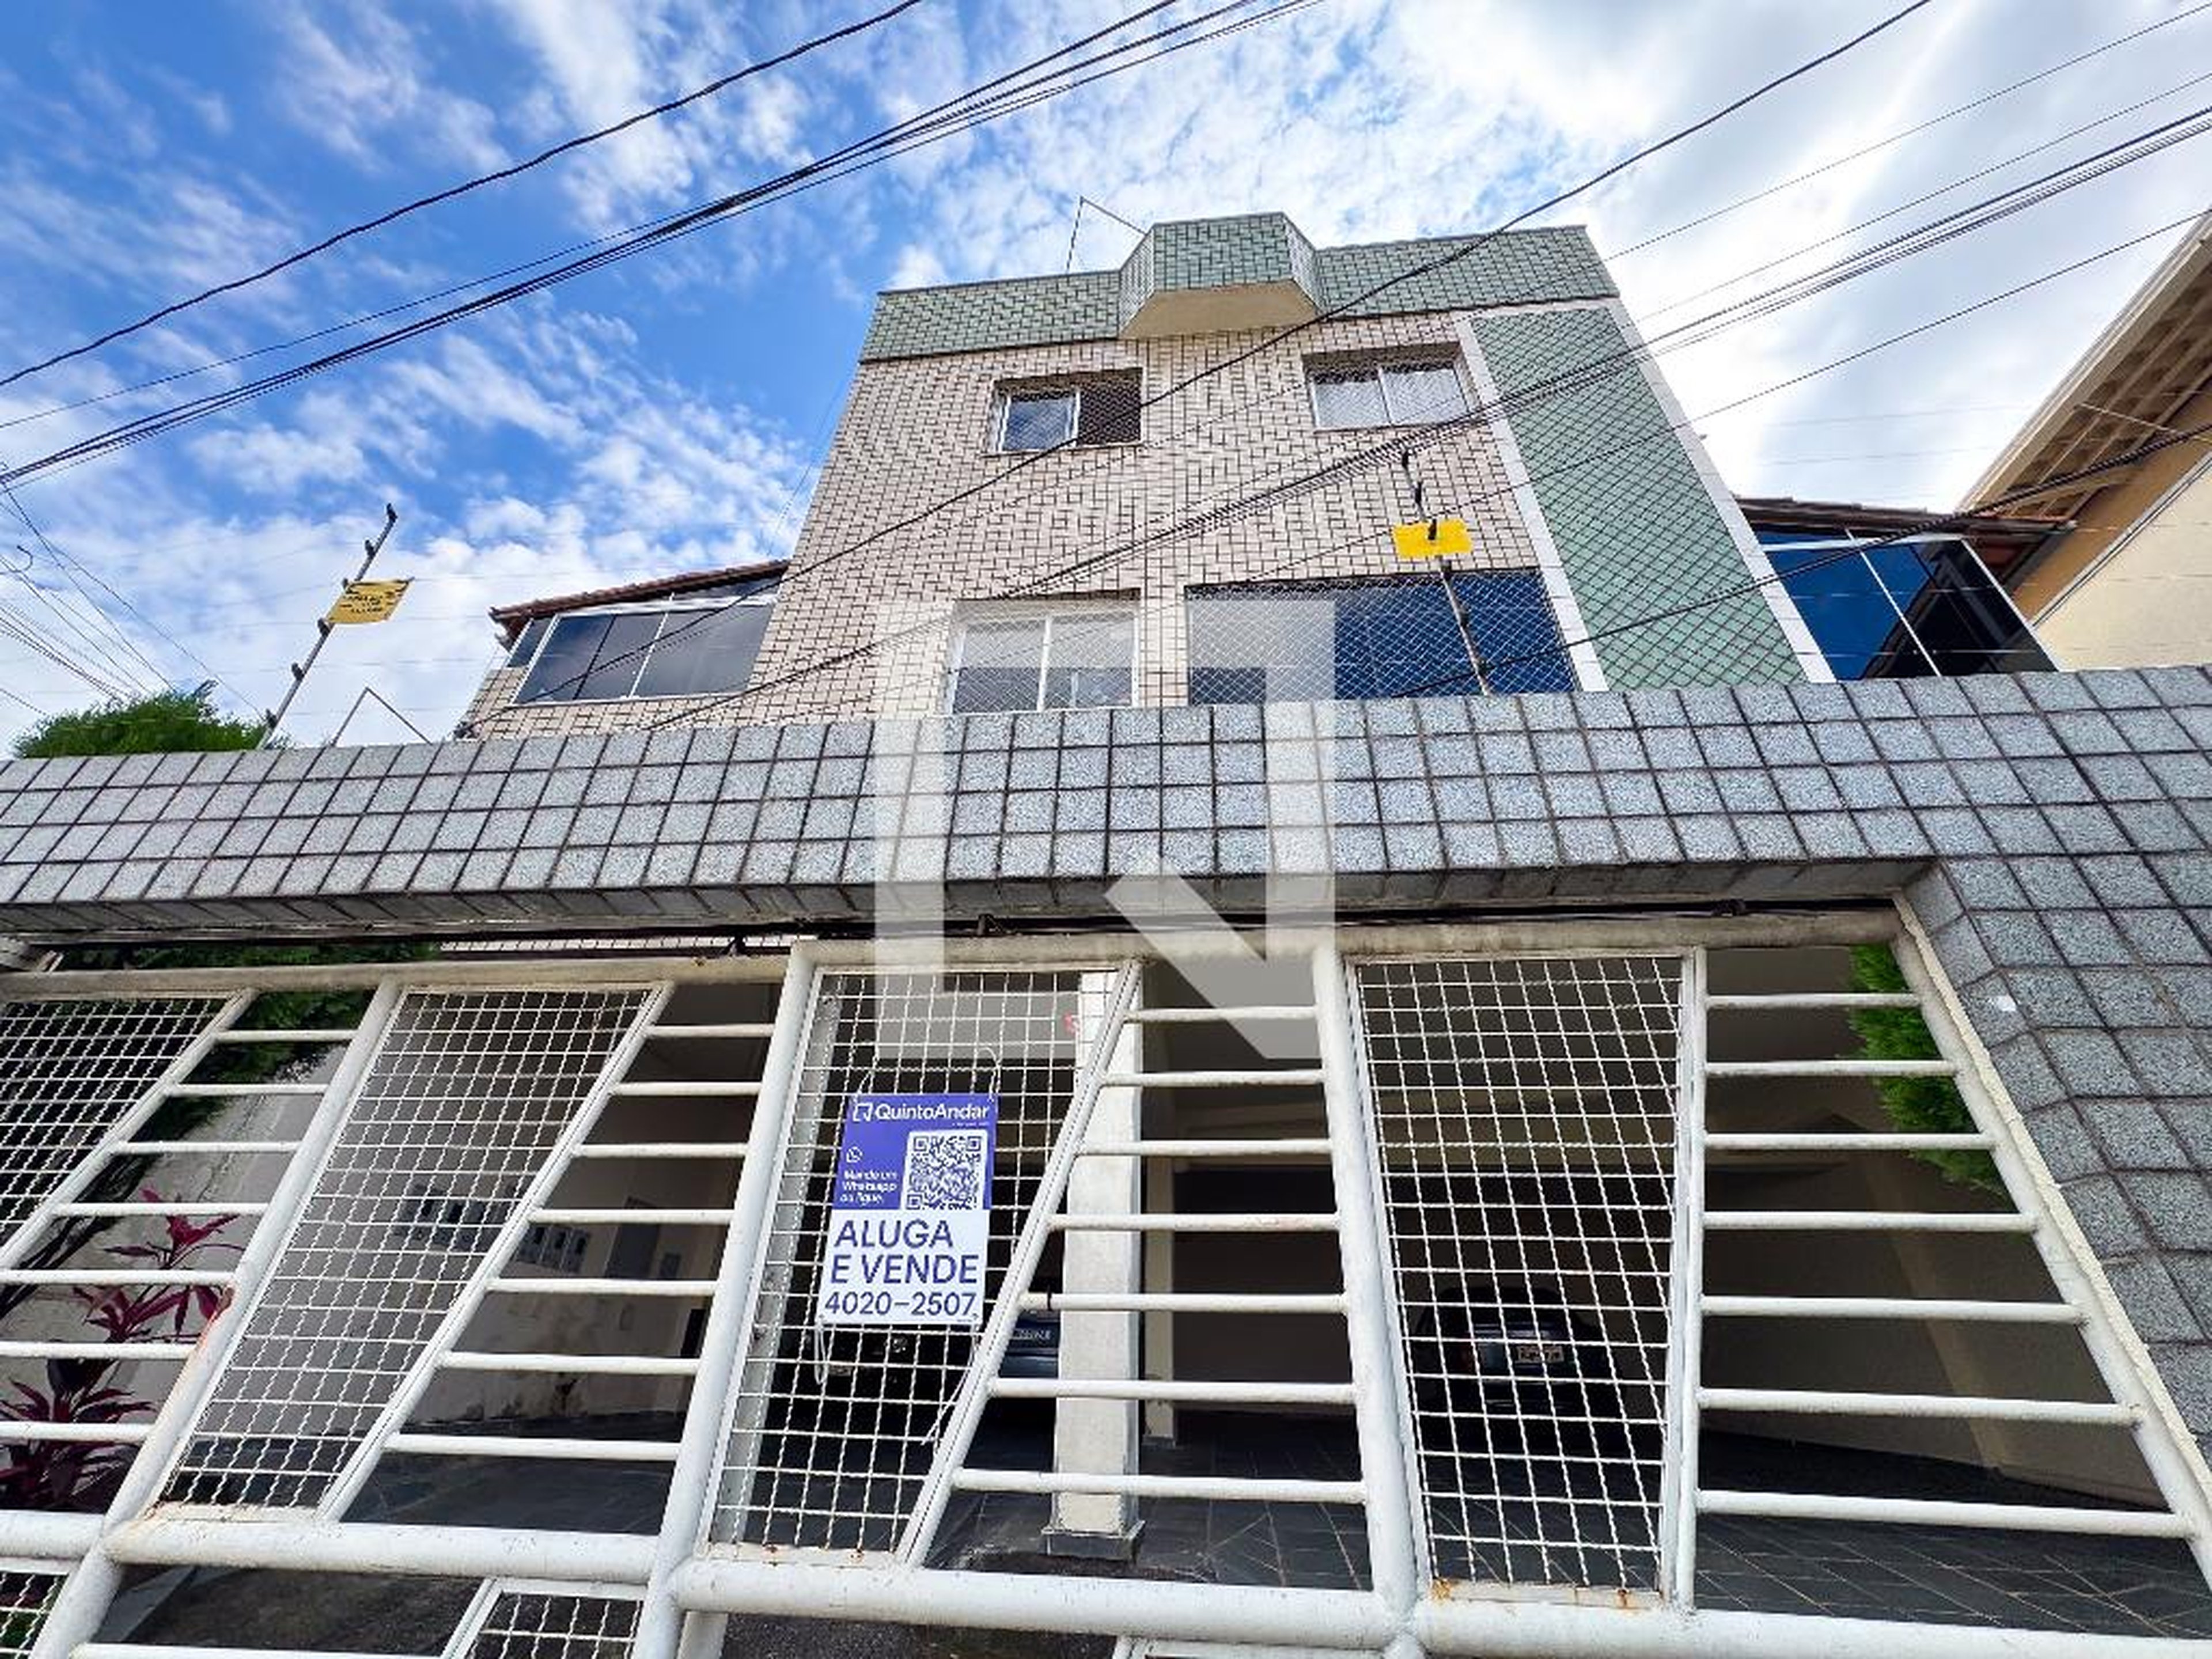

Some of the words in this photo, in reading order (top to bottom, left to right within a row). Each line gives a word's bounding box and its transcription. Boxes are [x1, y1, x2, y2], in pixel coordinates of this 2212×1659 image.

[874, 1103, 990, 1120] QuintoAndar
[834, 1218, 953, 1248] ALUGA
[831, 1254, 852, 1284] E
[861, 1254, 979, 1284] VENDE
[824, 1291, 978, 1316] 4020-2507
